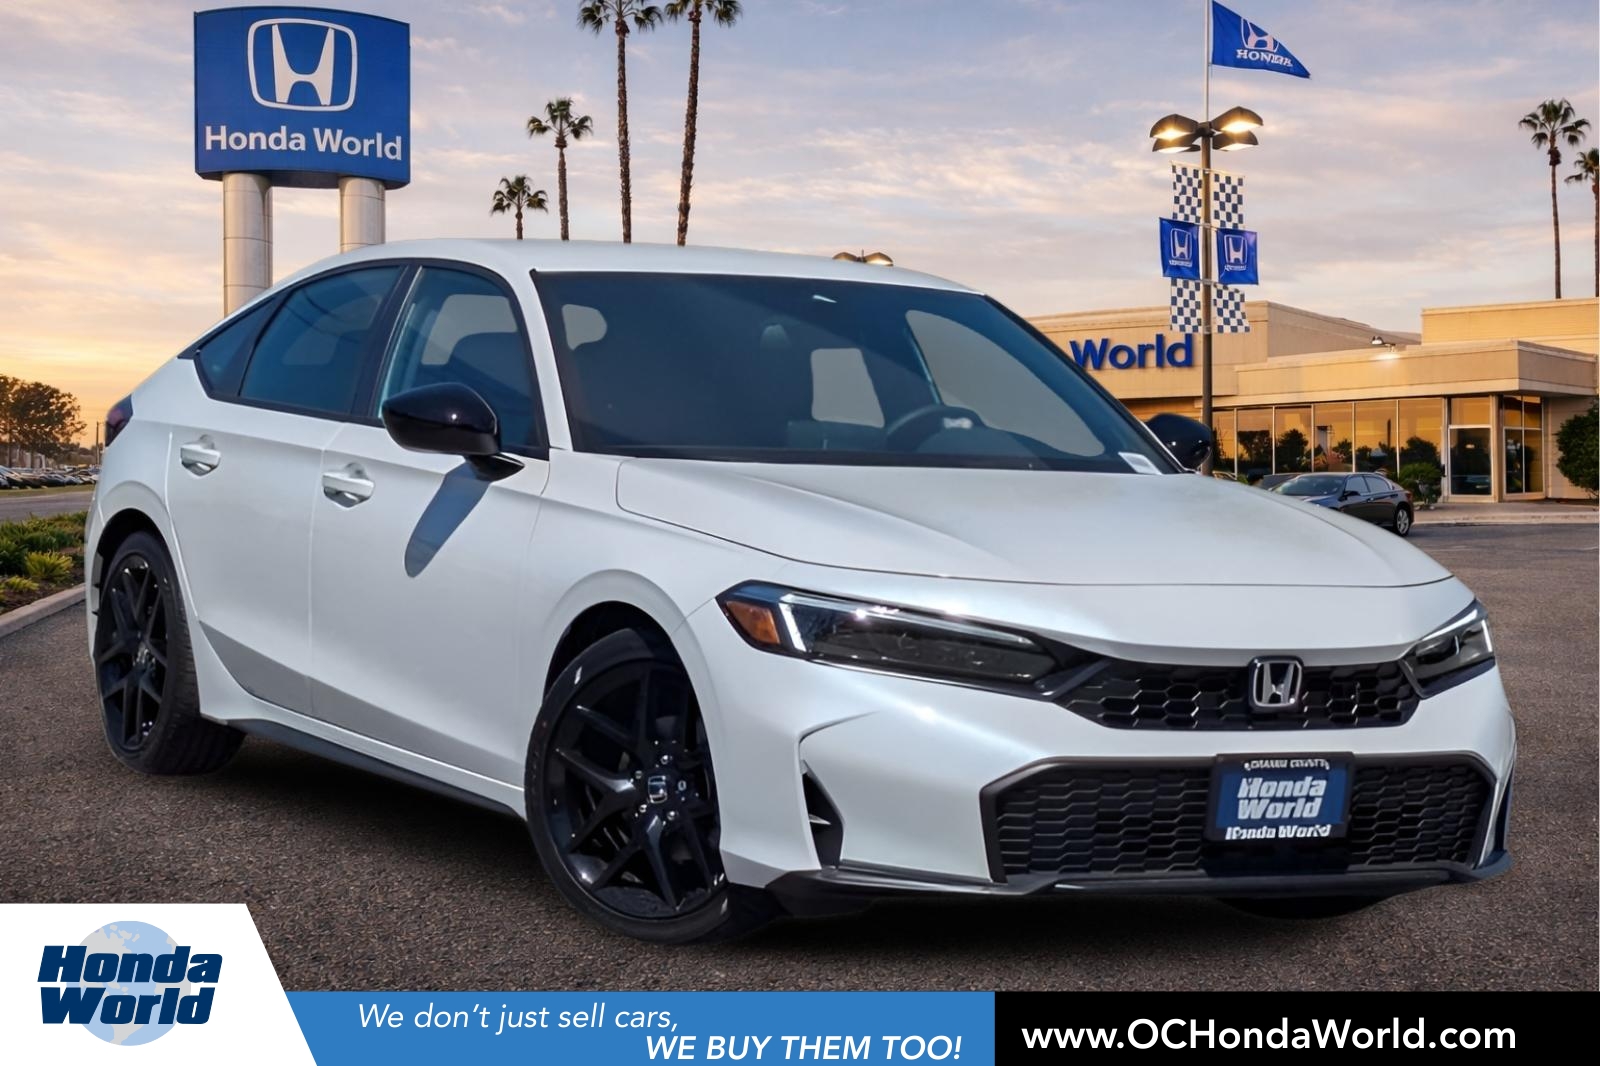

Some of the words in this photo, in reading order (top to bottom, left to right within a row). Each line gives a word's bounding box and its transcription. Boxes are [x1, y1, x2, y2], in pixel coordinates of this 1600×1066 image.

[205, 125, 305, 151] Honda
[313, 128, 402, 161] World
[1069, 333, 1194, 370] World
[1237, 776, 1328, 797] Honda
[1237, 797, 1323, 820] World
